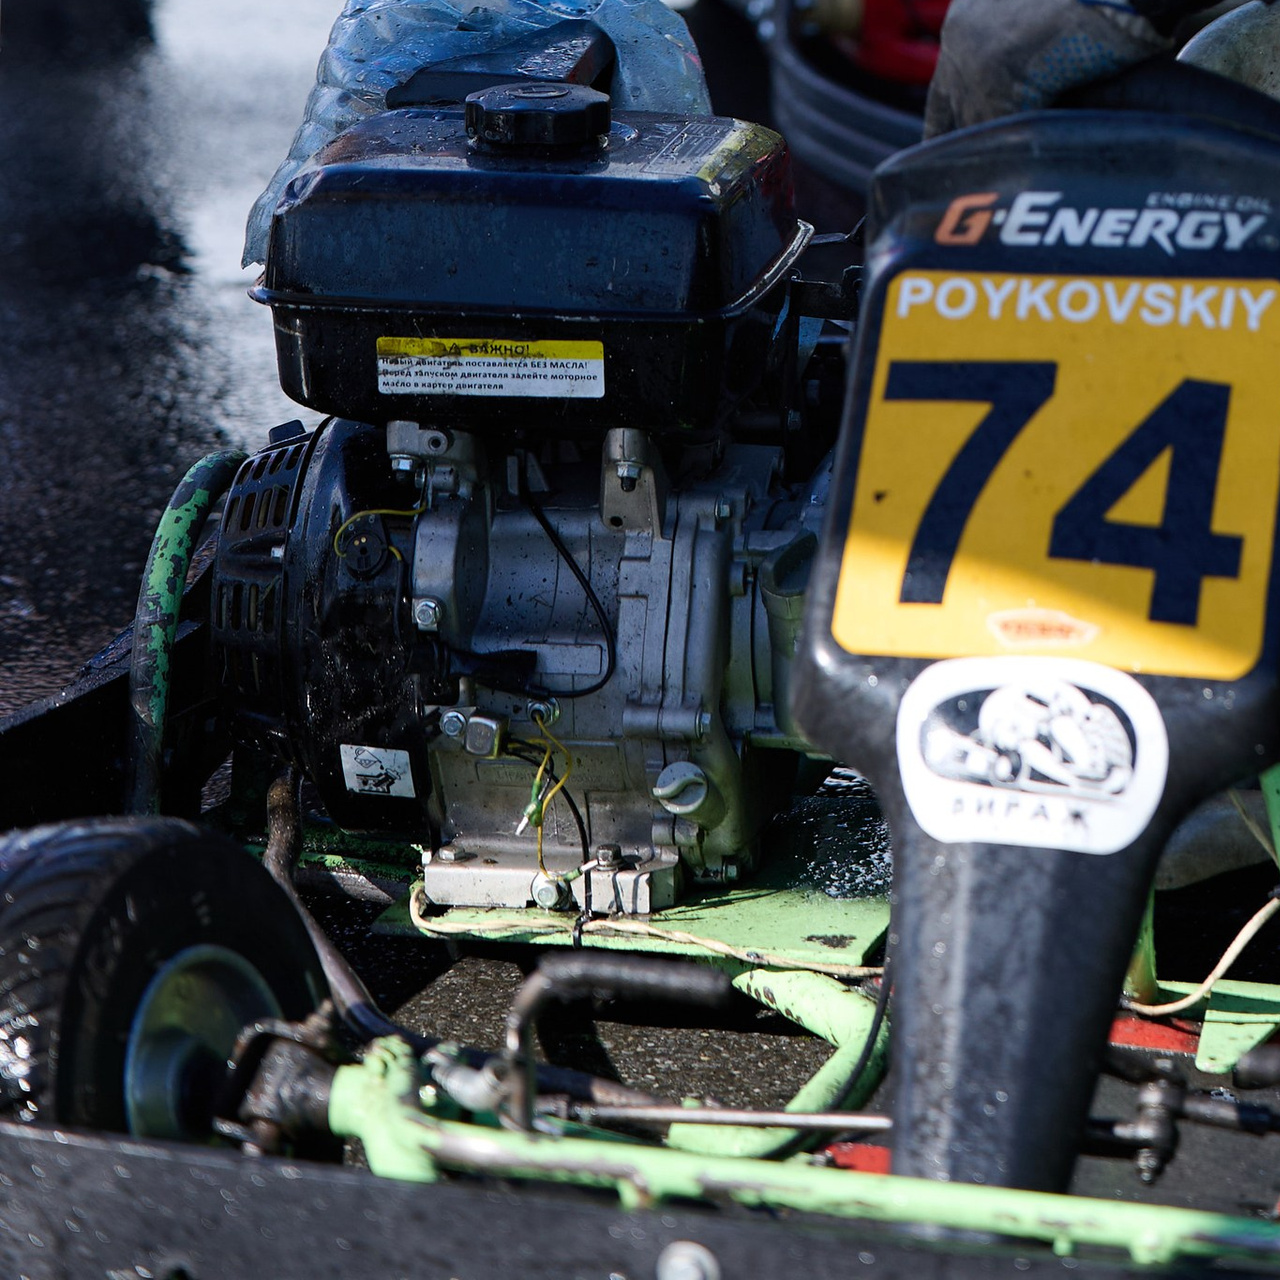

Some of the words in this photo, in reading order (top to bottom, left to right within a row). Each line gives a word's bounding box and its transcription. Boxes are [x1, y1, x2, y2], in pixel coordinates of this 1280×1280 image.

[896, 276, 1276, 331] POYKOVSKIY
[415, 359, 463, 367] двигатель
[465, 360, 528, 368] поставляется
[549, 361, 588, 369] МАСЛА!
[510, 371, 548, 379] залейте
[421, 382, 453, 390] картер
[883, 360, 1244, 628] 74
